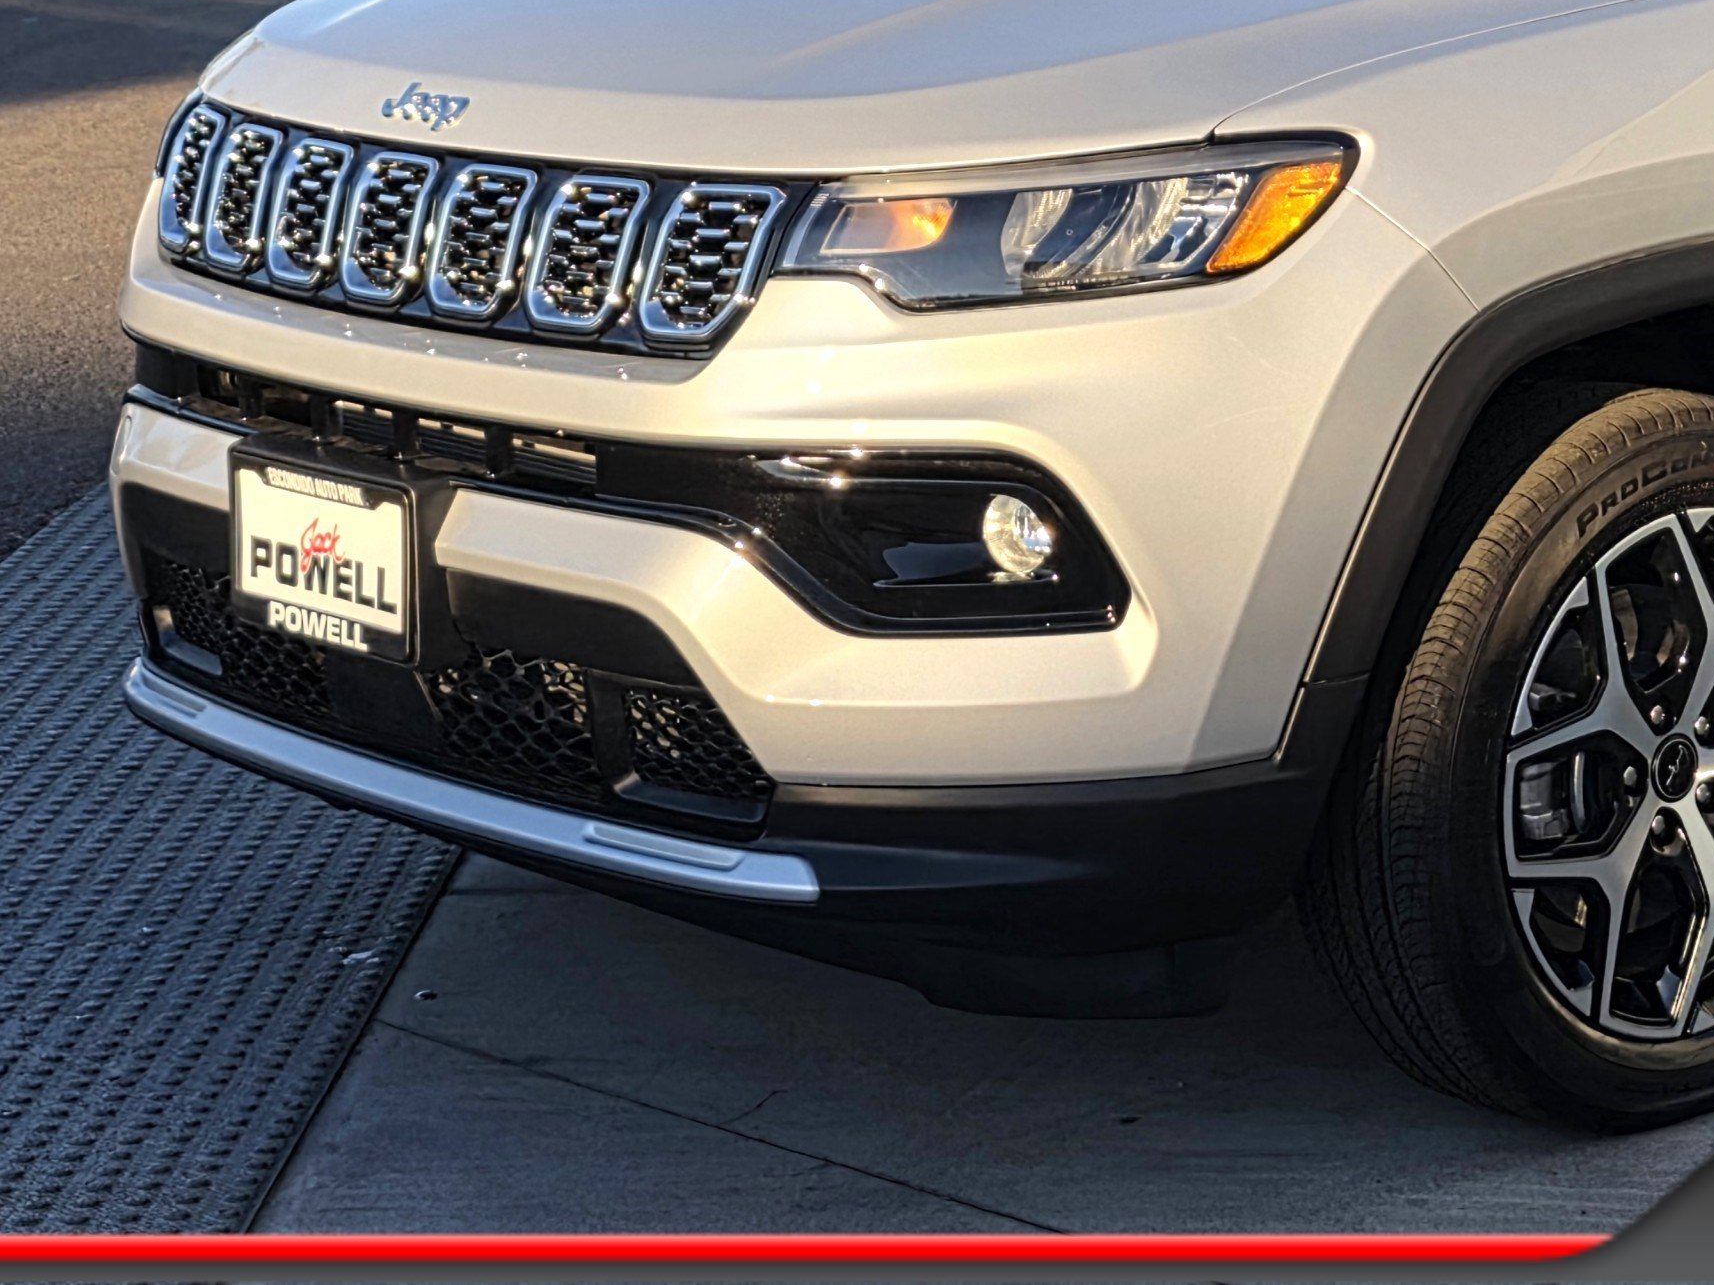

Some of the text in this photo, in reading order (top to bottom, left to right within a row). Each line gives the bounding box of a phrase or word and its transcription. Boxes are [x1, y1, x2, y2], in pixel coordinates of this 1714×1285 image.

[381, 81, 471, 132] Jeep
[315, 478, 338, 502] AUTO
[339, 483, 366, 507] PARK
[300, 516, 346, 575] Jack
[250, 534, 398, 615] POWELL
[268, 600, 369, 652] POWELL
